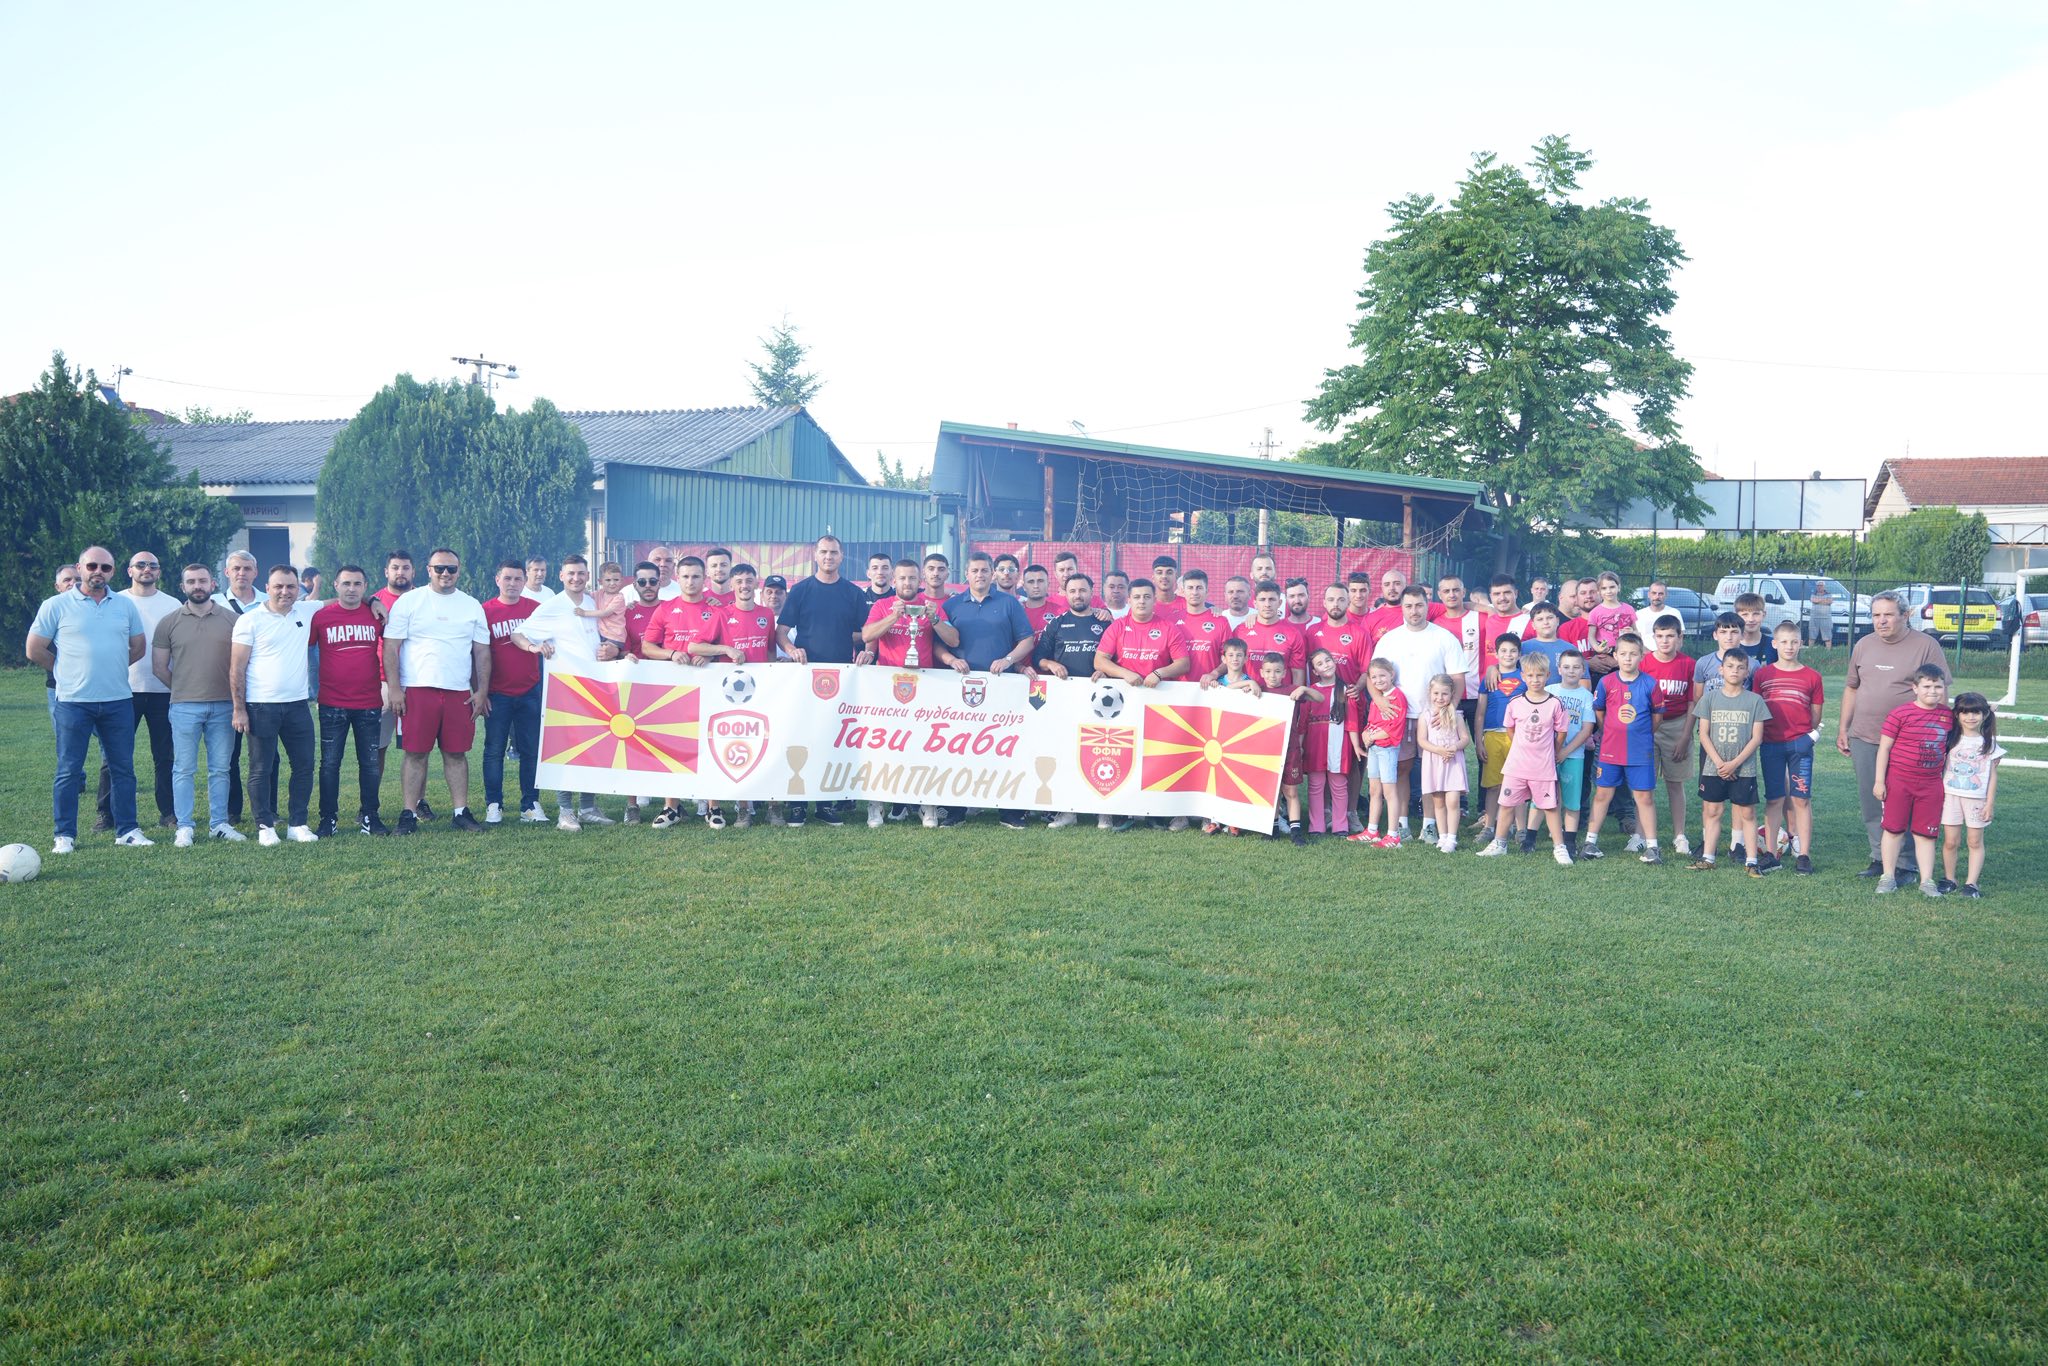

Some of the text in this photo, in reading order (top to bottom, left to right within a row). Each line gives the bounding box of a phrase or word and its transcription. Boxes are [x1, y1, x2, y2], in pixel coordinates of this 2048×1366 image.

[243, 506, 280, 516] МАРИНО
[326, 624, 376, 644] МАРИНО
[1659, 679, 1689, 697] РИНО
[838, 702, 1024, 727] Општински фудбалски сојуз
[717, 721, 760, 737] ФФМ
[833, 718, 1020, 758] Гази Баба
[1718, 726, 1738, 743] 92
[1091, 746, 1122, 756] ФФМ
[819, 760, 1026, 801] ШАМПИОНИ
